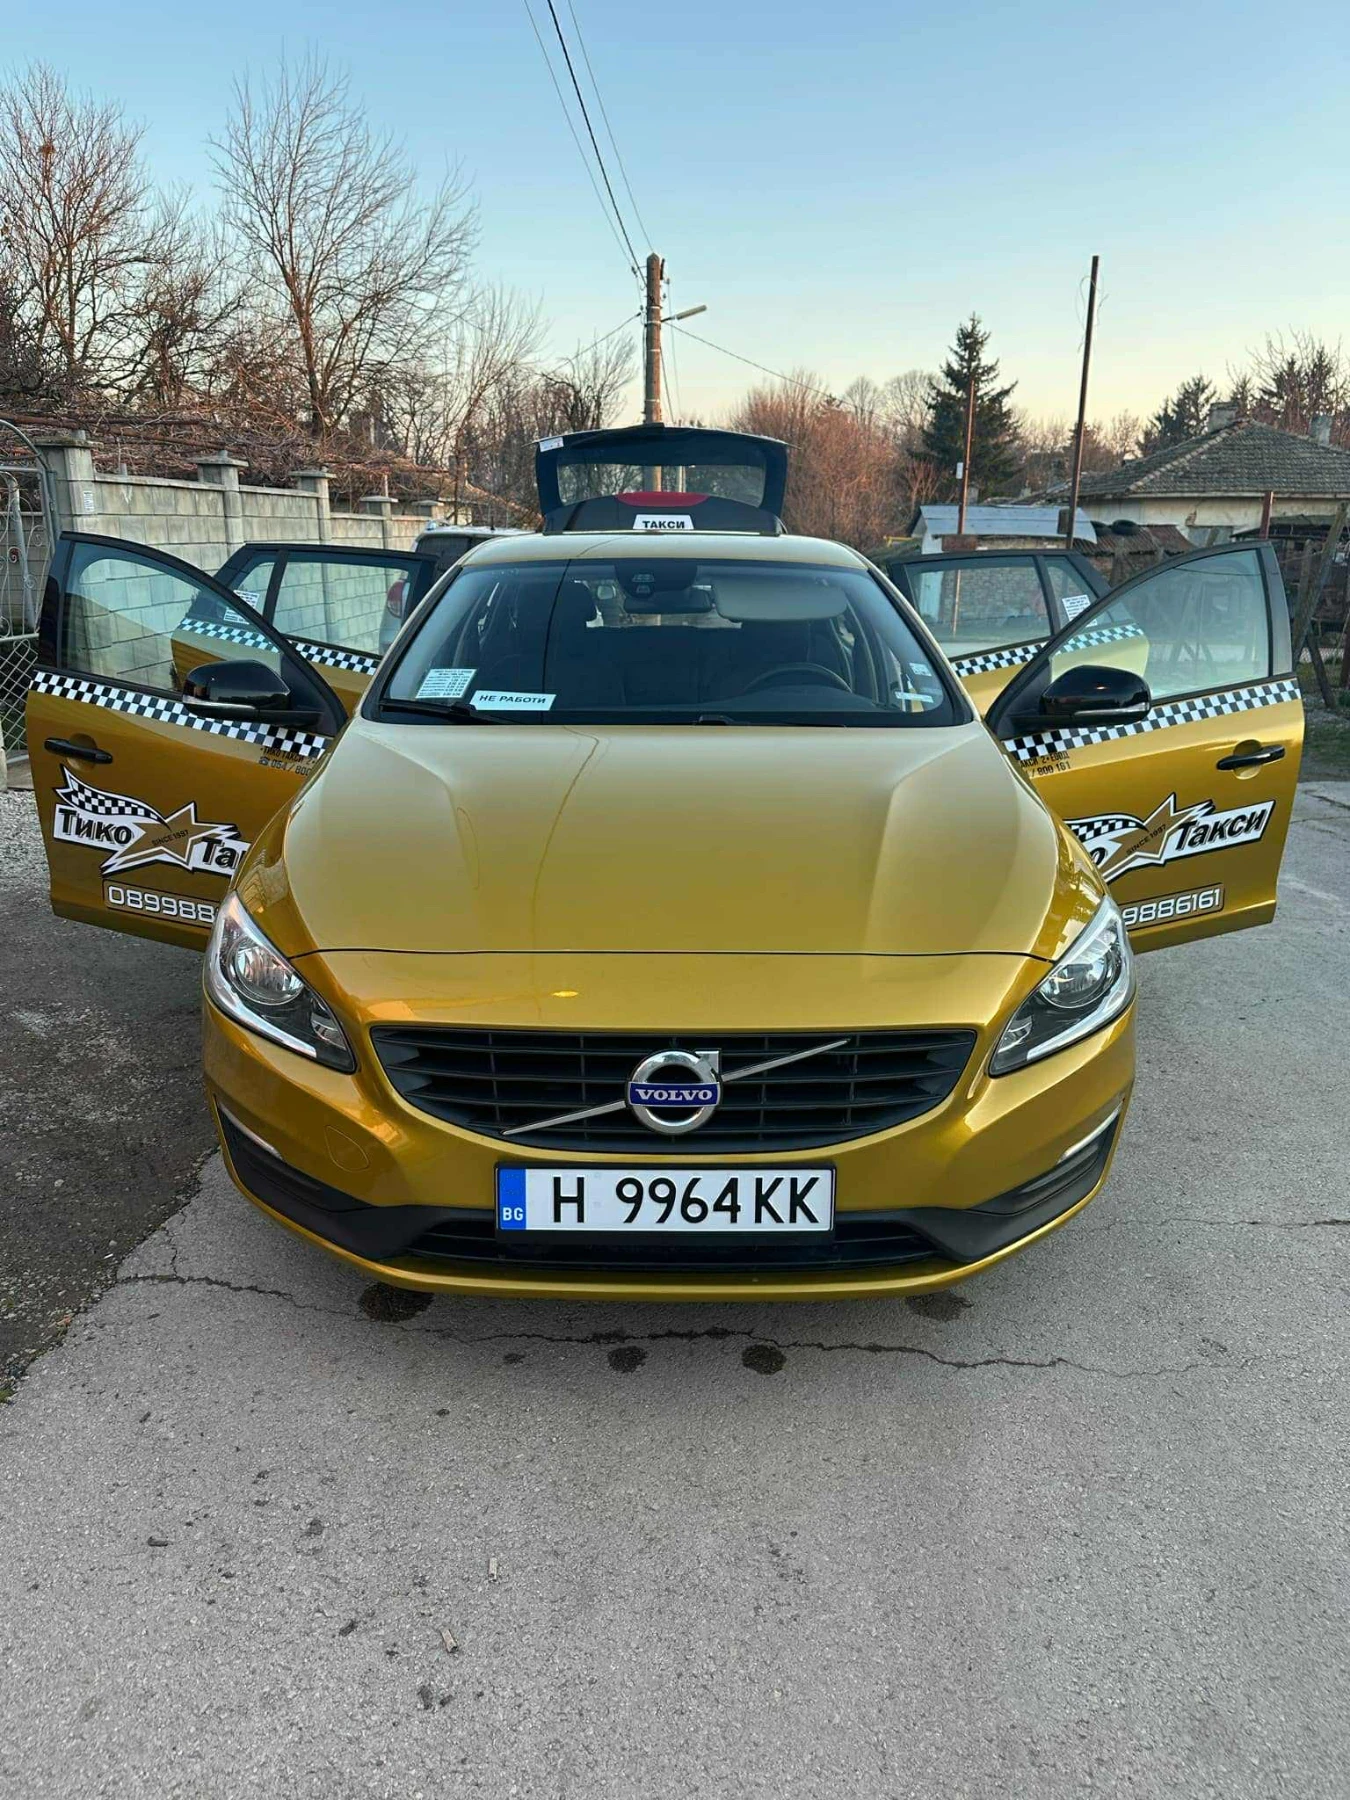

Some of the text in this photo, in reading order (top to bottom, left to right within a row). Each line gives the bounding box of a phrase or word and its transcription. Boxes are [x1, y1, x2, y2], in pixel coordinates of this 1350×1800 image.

[642, 520, 685, 529] ТАКСИ
[479, 694, 547, 704] НЕ РАБОТИ
[1174, 808, 1266, 851] Такси
[151, 834, 173, 847] SINCE
[1125, 823, 1167, 855] SINCE 1997
[635, 1087, 713, 1101] VOLVO
[552, 1176, 585, 1223] H
[502, 1206, 524, 1221] BG
